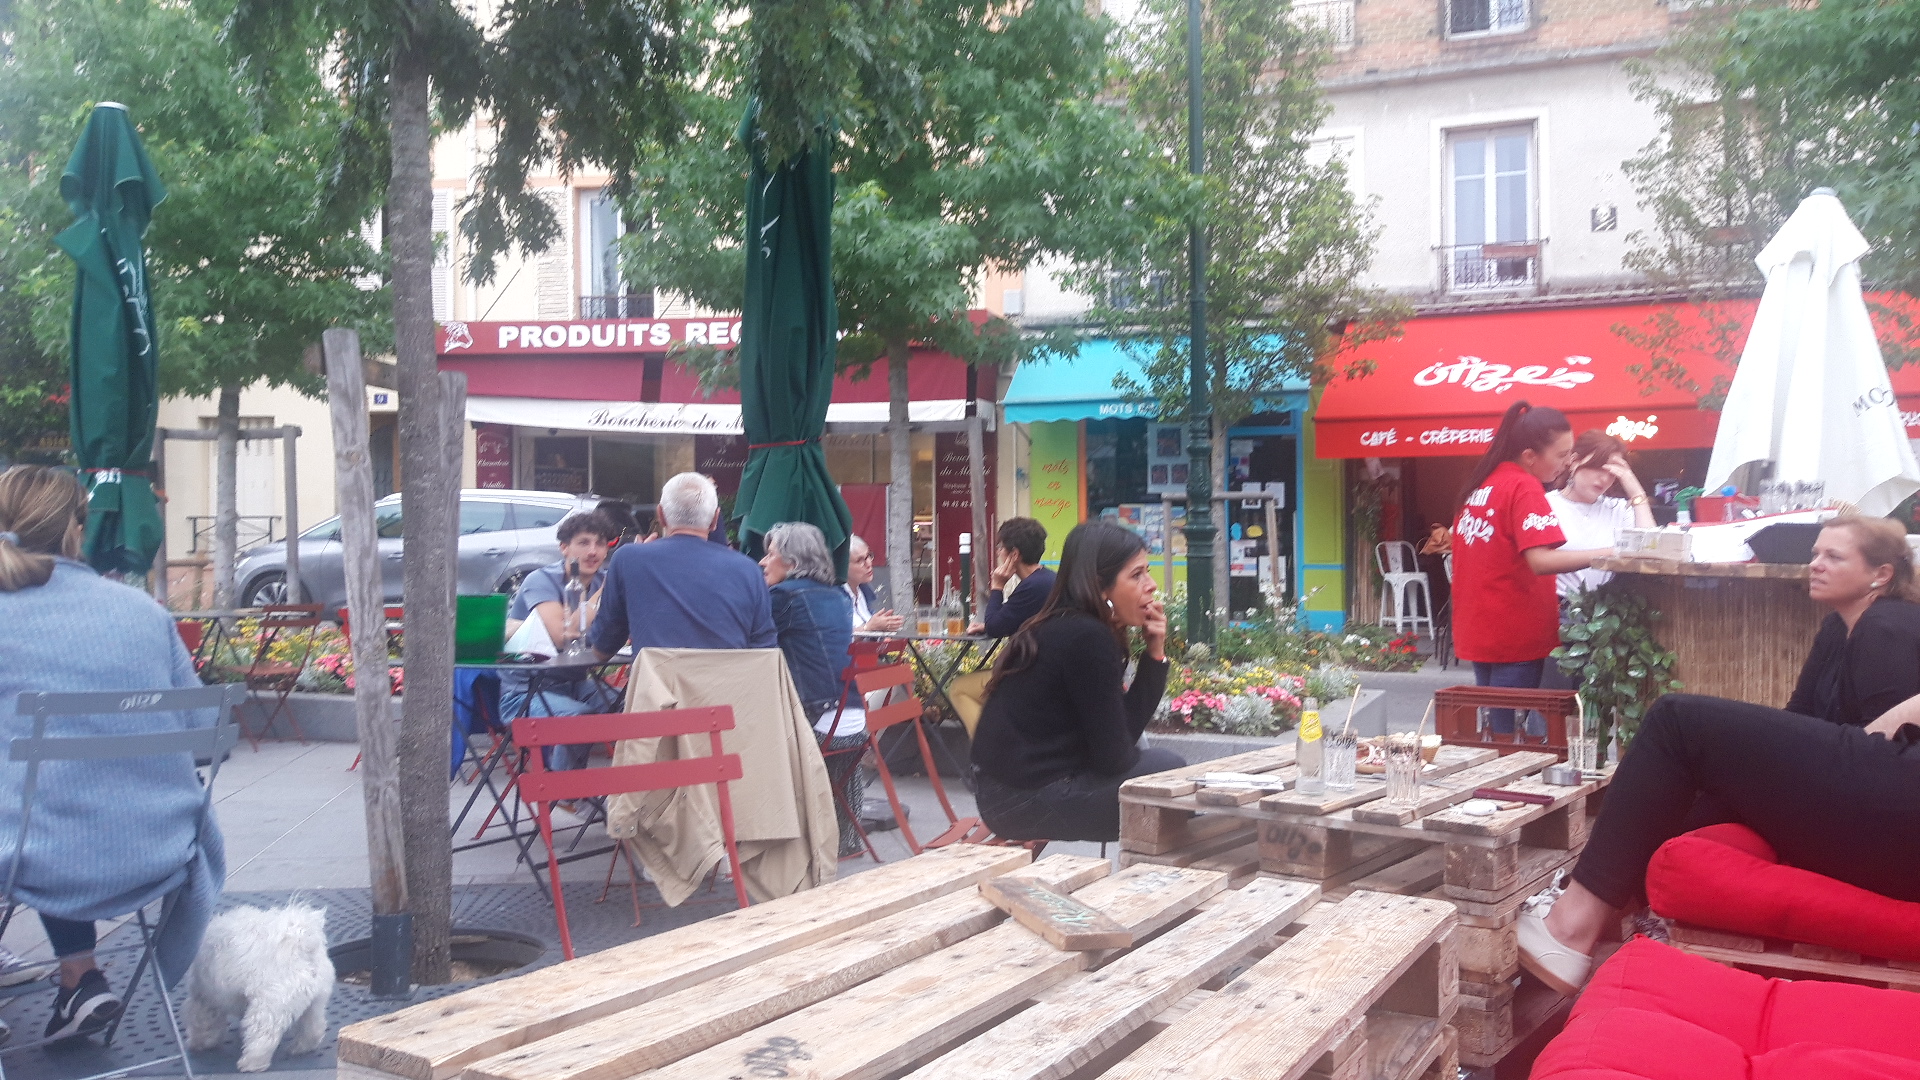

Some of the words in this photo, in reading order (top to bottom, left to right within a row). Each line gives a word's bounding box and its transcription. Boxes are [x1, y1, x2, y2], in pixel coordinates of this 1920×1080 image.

[498, 322, 672, 349] PRODUITS
[588, 408, 684, 429] Boucherie
[692, 413, 721, 429] du
[1099, 402, 1133, 416] MOTS
[1359, 427, 1398, 447] CAFÉ
[1419, 426, 1495, 445] CRÊPERIE
[954, 465, 991, 476] Mahé
